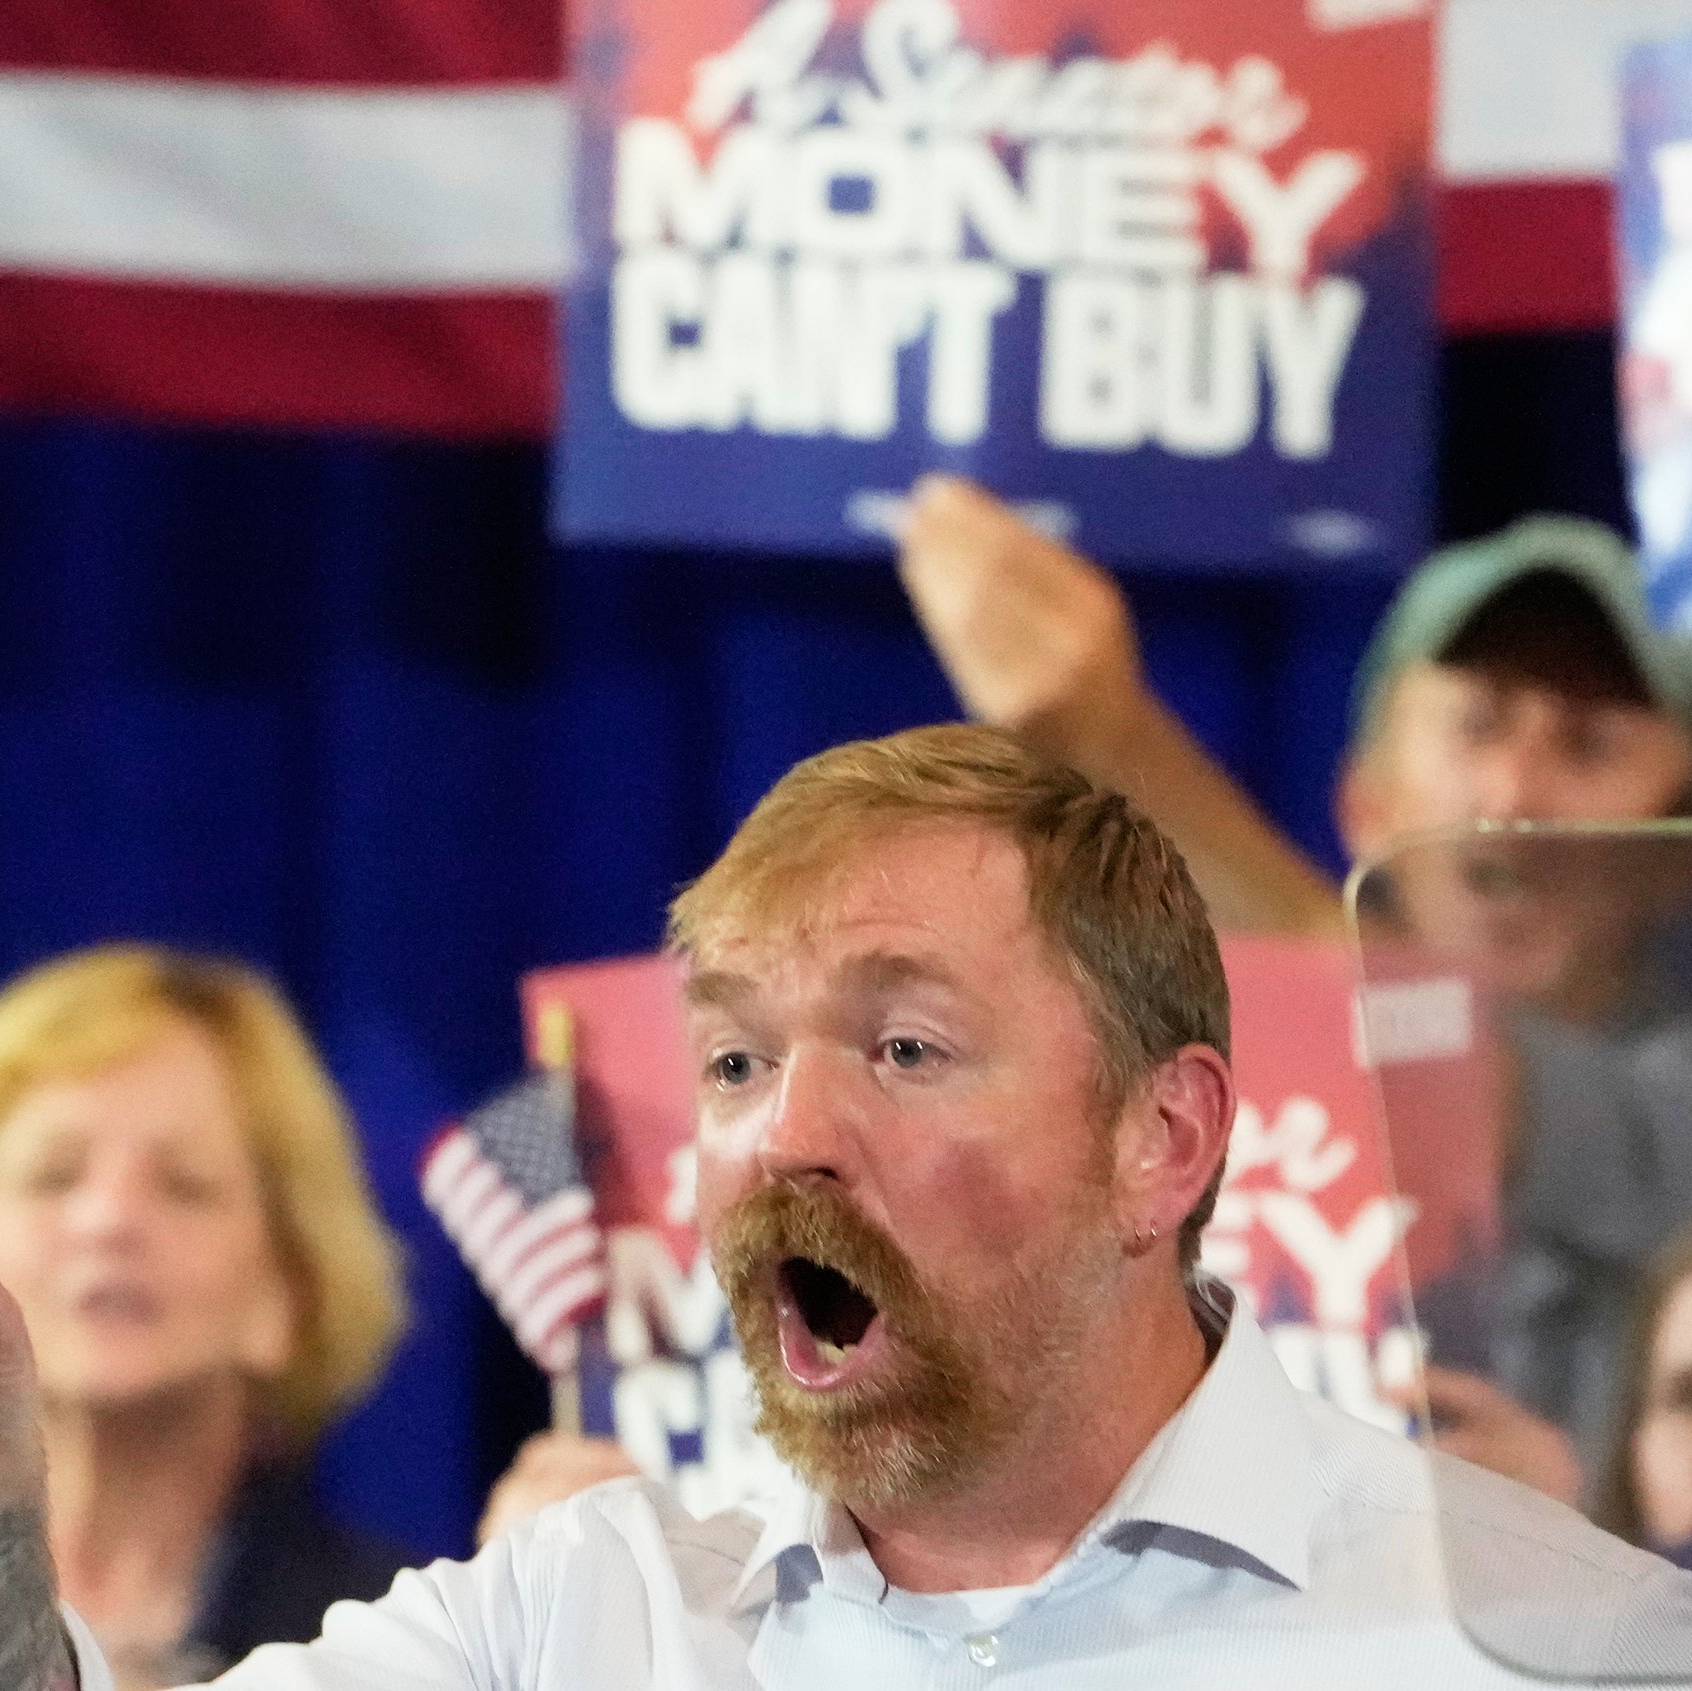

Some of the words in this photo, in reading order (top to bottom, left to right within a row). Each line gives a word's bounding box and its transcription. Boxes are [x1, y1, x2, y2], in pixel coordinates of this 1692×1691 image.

[612, 115, 1369, 283] MONEY
[611, 252, 1017, 447] CAN'T
[1039, 273, 1367, 461] BUY
